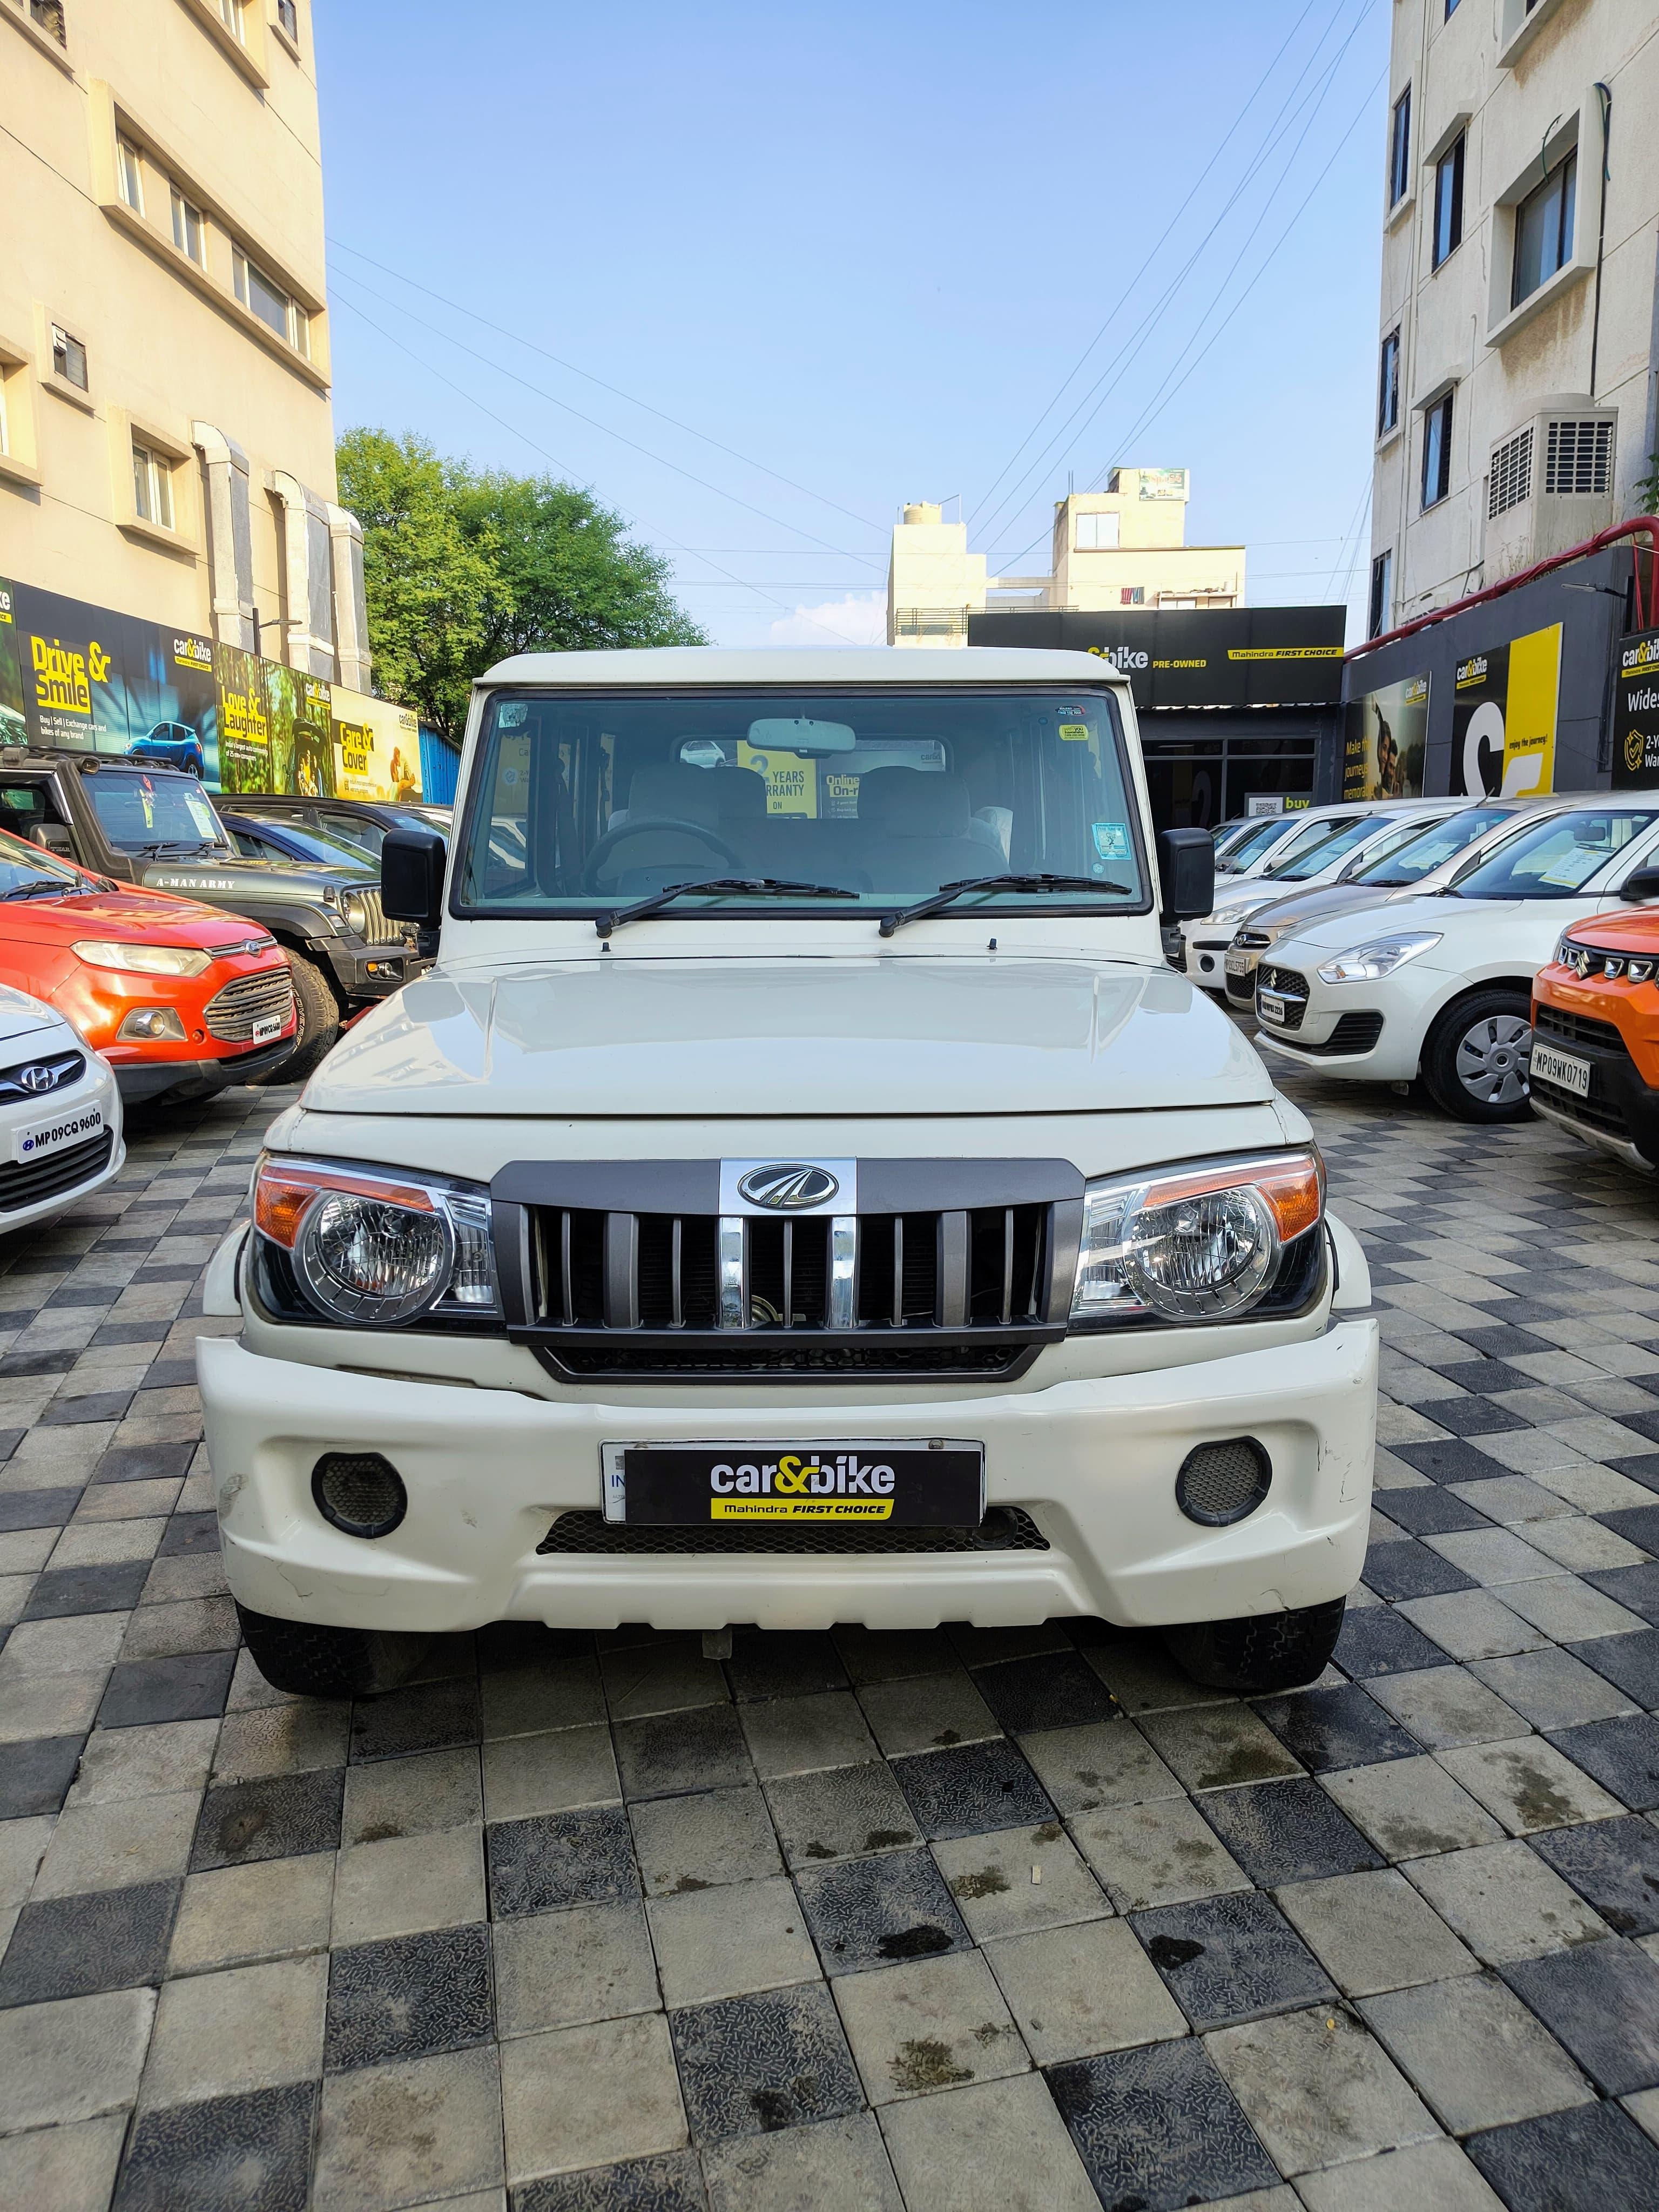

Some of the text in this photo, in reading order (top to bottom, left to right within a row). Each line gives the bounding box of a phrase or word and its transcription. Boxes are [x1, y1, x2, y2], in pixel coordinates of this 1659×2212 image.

[174, 638, 211, 662] car&bike
[31, 636, 111, 683] Drive &
[1152, 659, 1206, 668] PRE-OWNED
[1457, 657, 1487, 680] car&bike
[36, 669, 88, 707] Smile
[306, 682, 331, 702] car&bike
[1406, 679, 1427, 698] car&bike
[222, 685, 260, 716] Love &
[39, 715, 50, 725] Buy
[53, 717, 63, 725] Sell
[65, 719, 88, 730] Exchange
[224, 707, 266, 738] Laughter
[399, 713, 416, 728] car&bike
[41, 726, 54, 736] bikes
[60, 731, 70, 739] any
[70, 730, 84, 739] brand
[340, 722, 374, 751] Care &
[1346, 738, 1361, 756] Make
[1509, 739, 1520, 751] enjoy
[1529, 733, 1548, 748] journey!
[342, 745, 367, 771] Cover
[773, 771, 804, 783] YEARS
[826, 773, 860, 785] Online
[1344, 763, 1369, 782] journeys
[766, 784, 804, 797] RRANTY
[833, 786, 858, 795] On-r
[773, 801, 782, 810] ON
[1286, 797, 1310, 808] buy
[156, 878, 235, 889] A-MAN ARMY
[1536, 1051, 1587, 1090] MP09WK0719
[611, 1474, 625, 1487] IN
[711, 1456, 895, 1493] car&bike
[724, 1505, 886, 1514] Mahindra FIRST CHOICE
